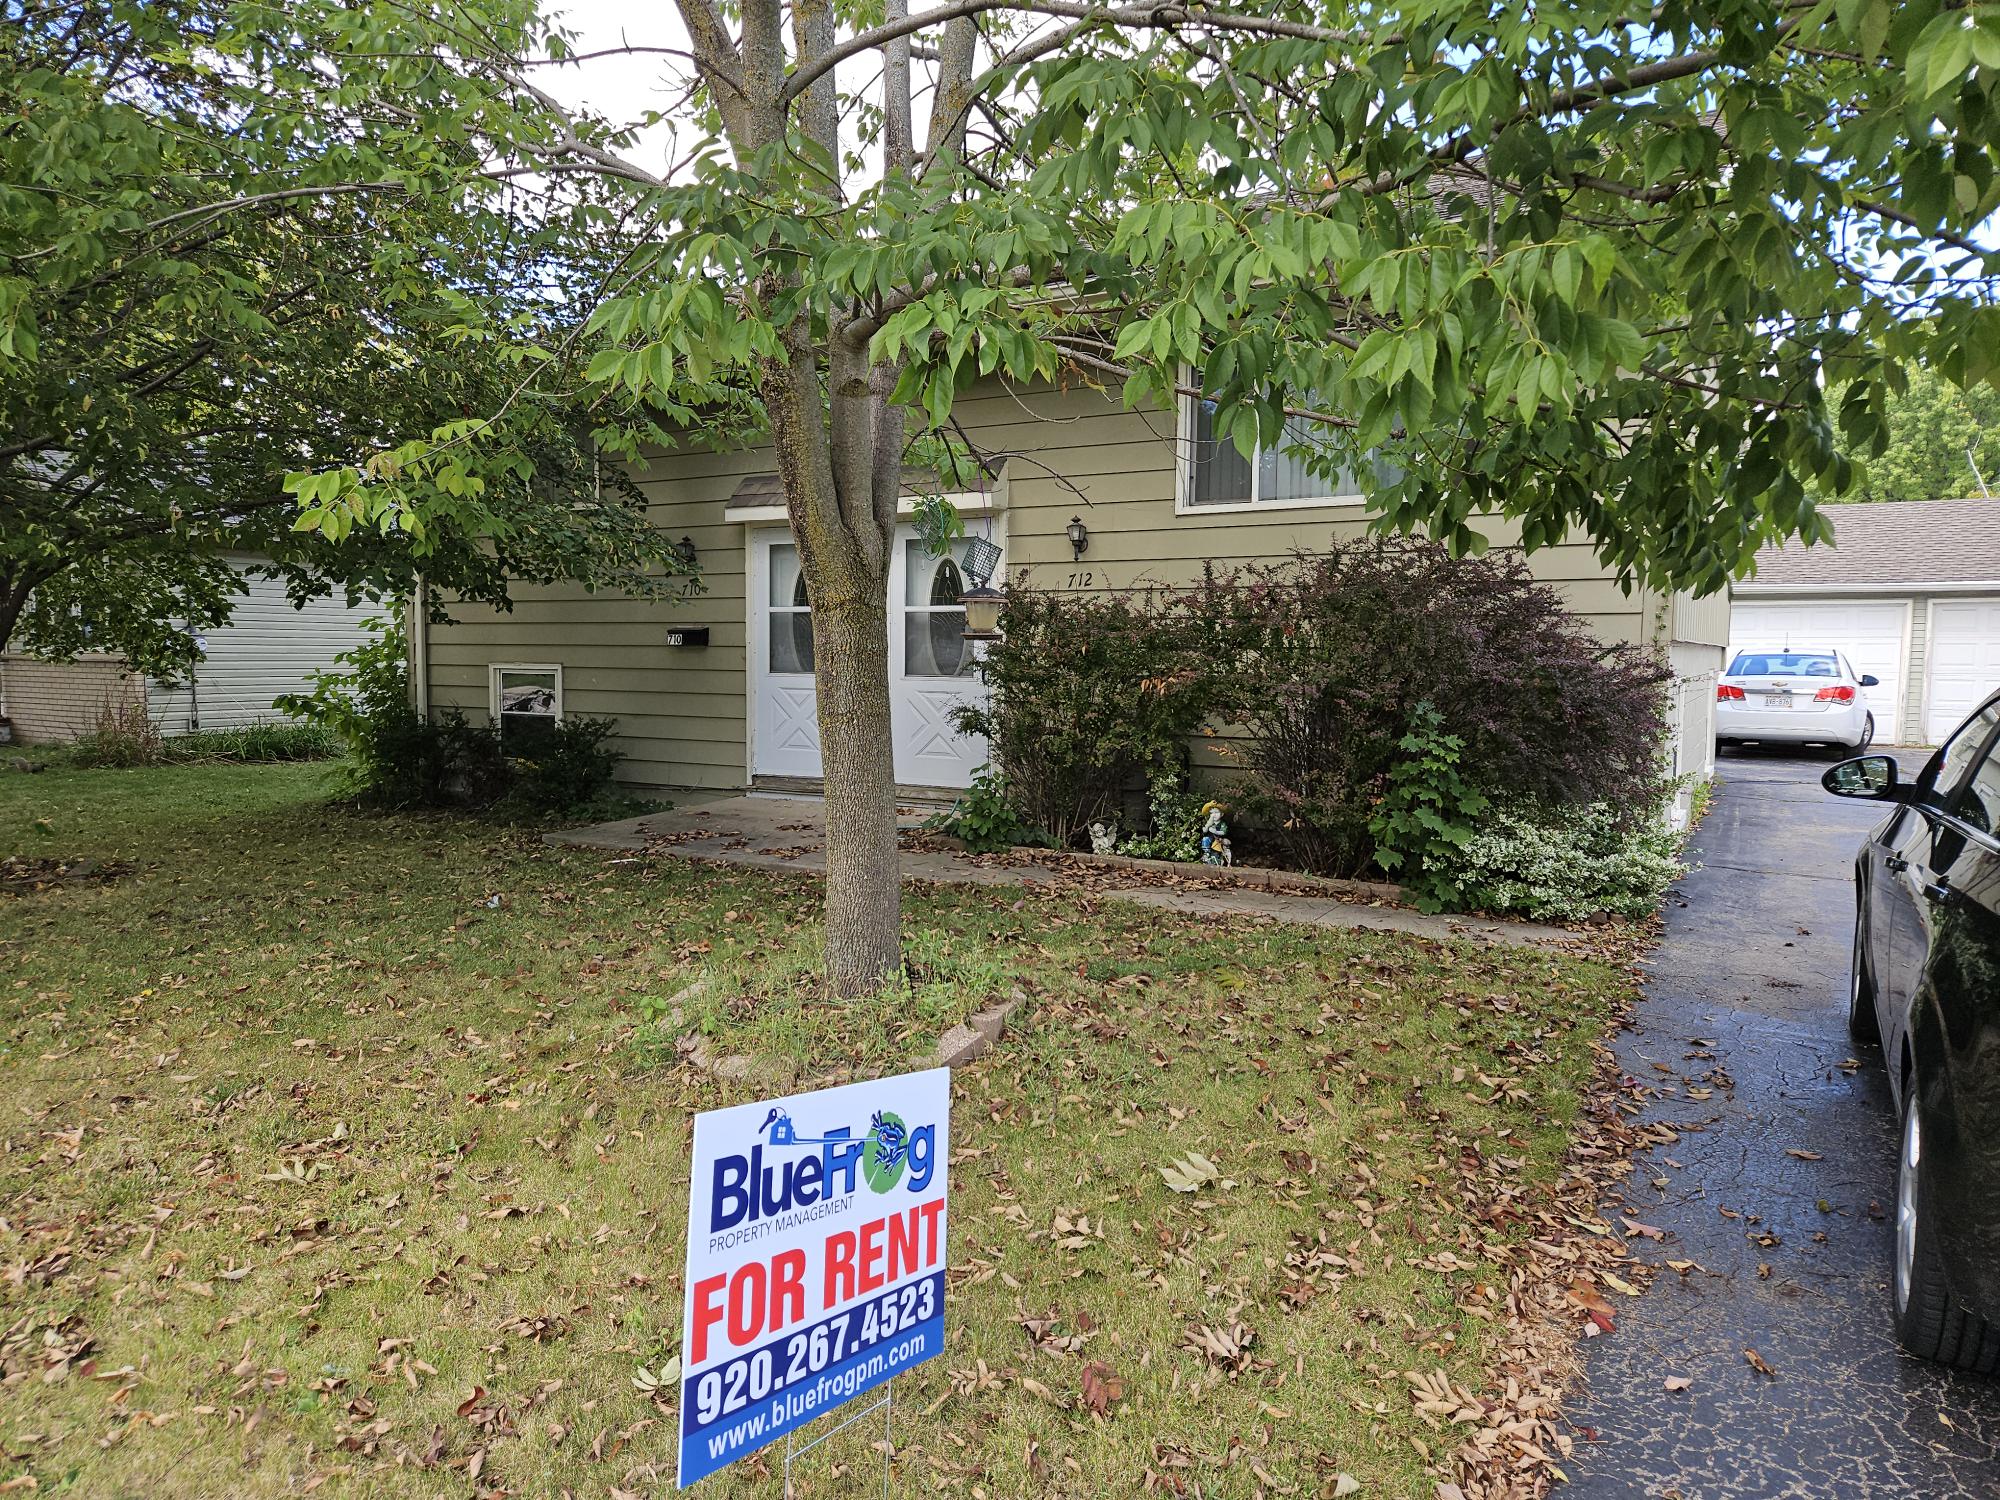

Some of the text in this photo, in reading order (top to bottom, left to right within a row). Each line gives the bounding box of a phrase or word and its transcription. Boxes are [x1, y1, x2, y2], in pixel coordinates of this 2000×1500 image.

[682, 583, 701, 597] 710
[1068, 572, 1092, 588] 712
[667, 634, 682, 645] 710
[708, 1195, 855, 1255] PROPERTY MANAGEMENT
[690, 1197, 945, 1367] FOR RENT
[696, 1278, 936, 1425] 920.267.4523
[707, 1333, 926, 1461] www.bluefrogpm.com
